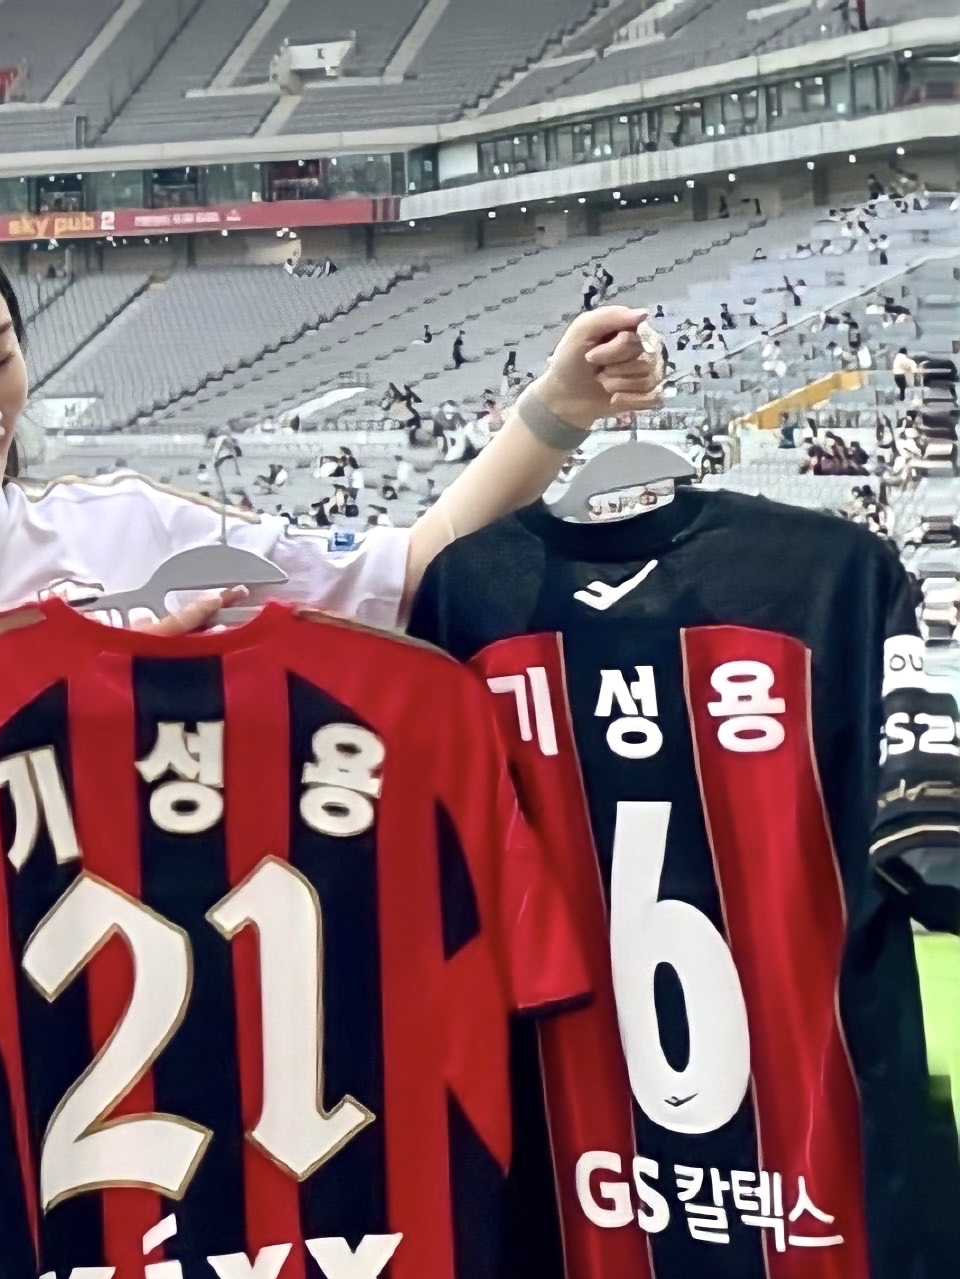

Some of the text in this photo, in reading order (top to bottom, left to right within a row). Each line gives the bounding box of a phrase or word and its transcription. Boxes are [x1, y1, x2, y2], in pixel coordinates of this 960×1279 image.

[21, 855, 377, 1214] 21
[610, 801, 751, 1135] 6
[575, 1150, 844, 1252] GS칼텍스
